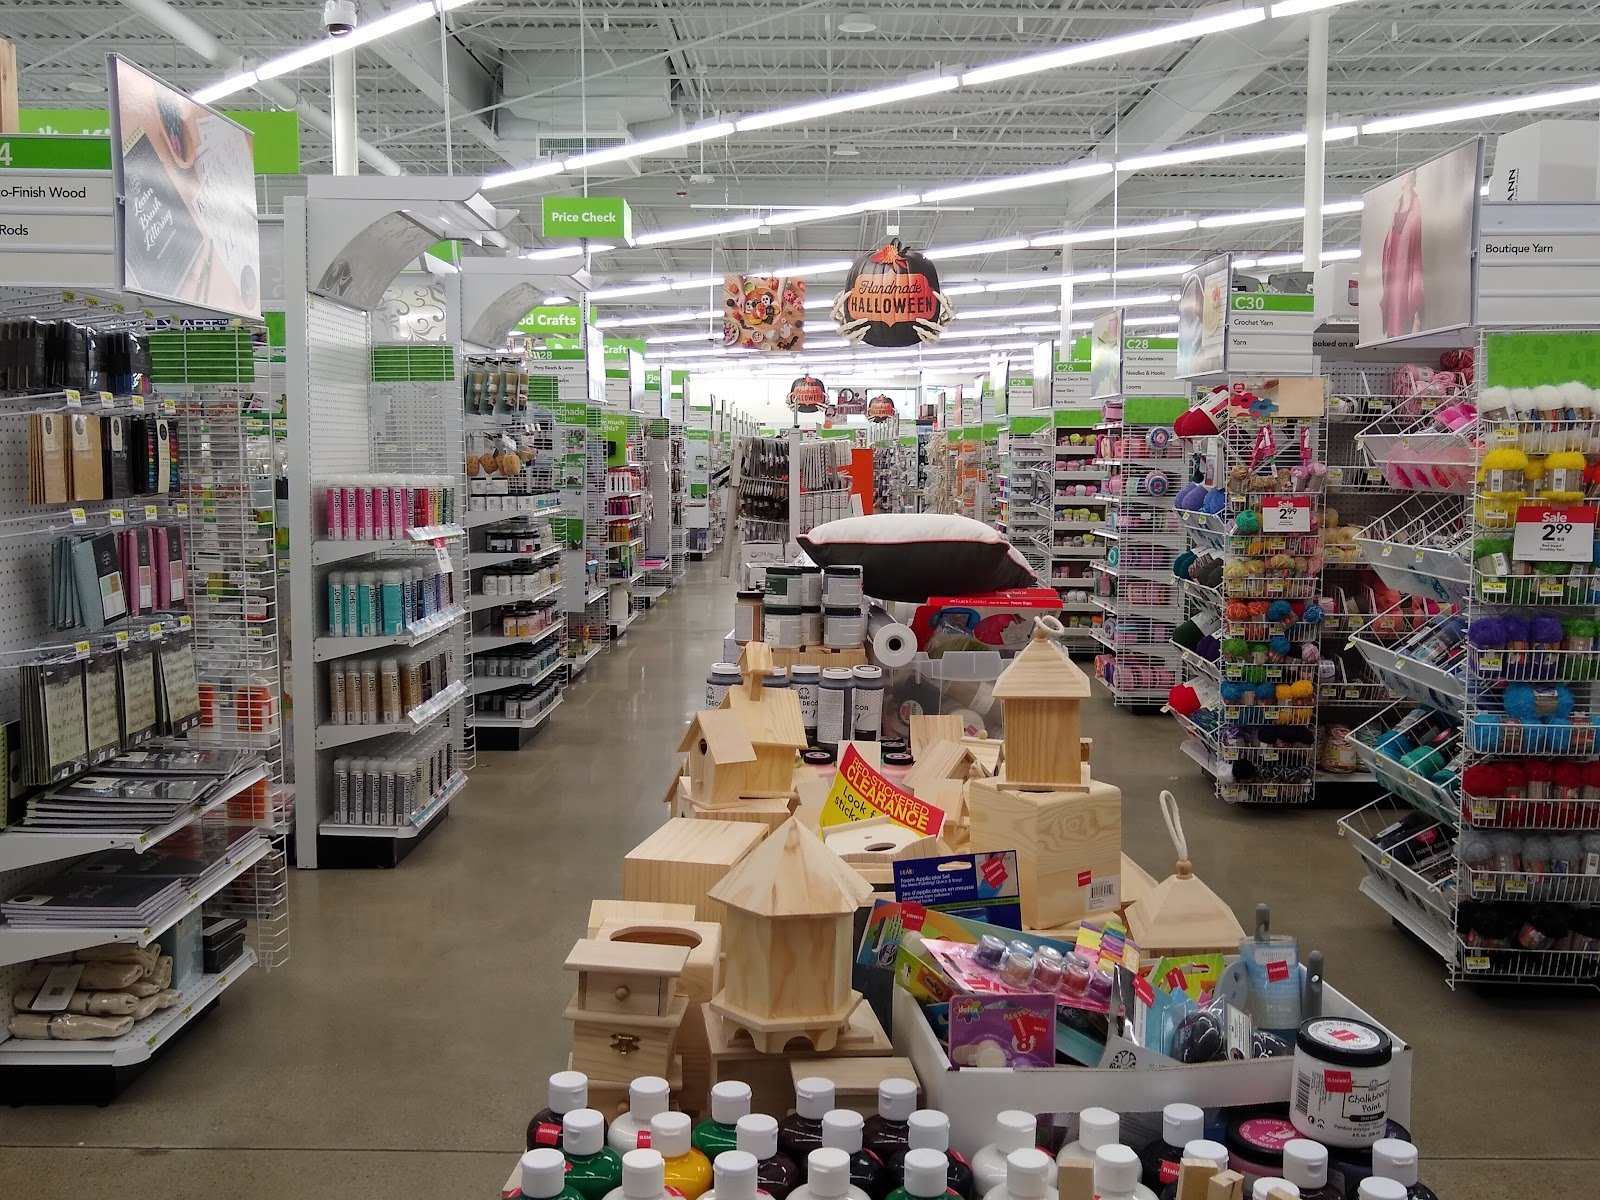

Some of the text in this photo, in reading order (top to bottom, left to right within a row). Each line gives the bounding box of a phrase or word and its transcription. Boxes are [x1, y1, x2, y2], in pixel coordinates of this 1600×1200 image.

[0, 186, 86, 198] o-Finish Wood
[133, 187, 154, 217] Learn
[139, 197, 162, 231] Brush
[552, 212, 616, 222] Price Check
[144, 209, 174, 252] Lettering
[1485, 244, 1554, 255] Boutique Yarn
[859, 280, 922, 295] Handmade
[851, 297, 932, 313] HALLOWEEN
[1235, 297, 1265, 310] C30
[537, 314, 577, 326] Crafts
[1233, 319, 1259, 327] Crochet
[1126, 339, 1149, 349] C28
[1056, 364, 1074, 372] C26
[1277, 500, 1294, 508] Sale
[1542, 512, 1567, 523] Sale
[852, 756, 930, 816] RED-STICKERED
[842, 785, 867, 815] Look
[846, 764, 930, 831] CLEARANCE
[916, 875, 941, 884] Applicator
[958, 1005, 977, 1013] delta
[1362, 1103, 1381, 1113] Paint
